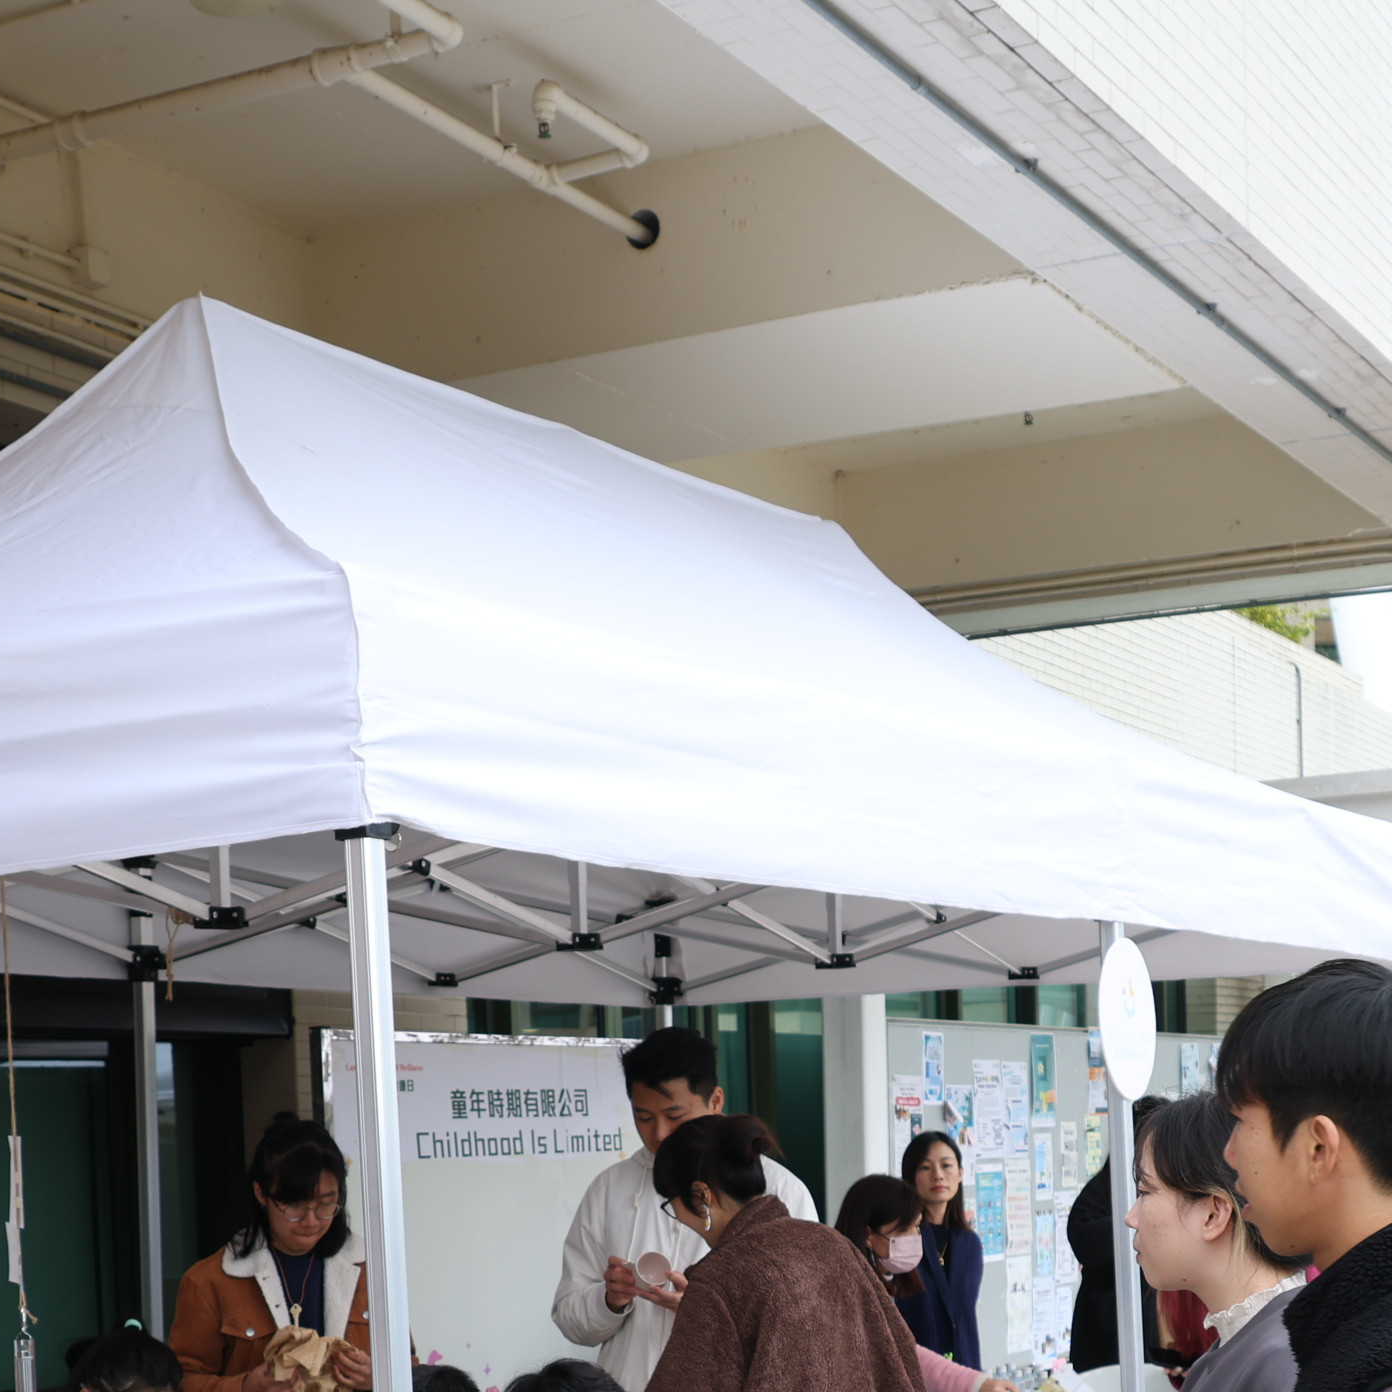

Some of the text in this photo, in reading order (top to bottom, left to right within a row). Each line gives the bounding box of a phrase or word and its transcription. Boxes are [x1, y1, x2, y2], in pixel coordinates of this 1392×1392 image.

[450, 1088, 589, 1120] 童年時期有限公司
[416, 1127, 623, 1160] Childhood Is Limited
